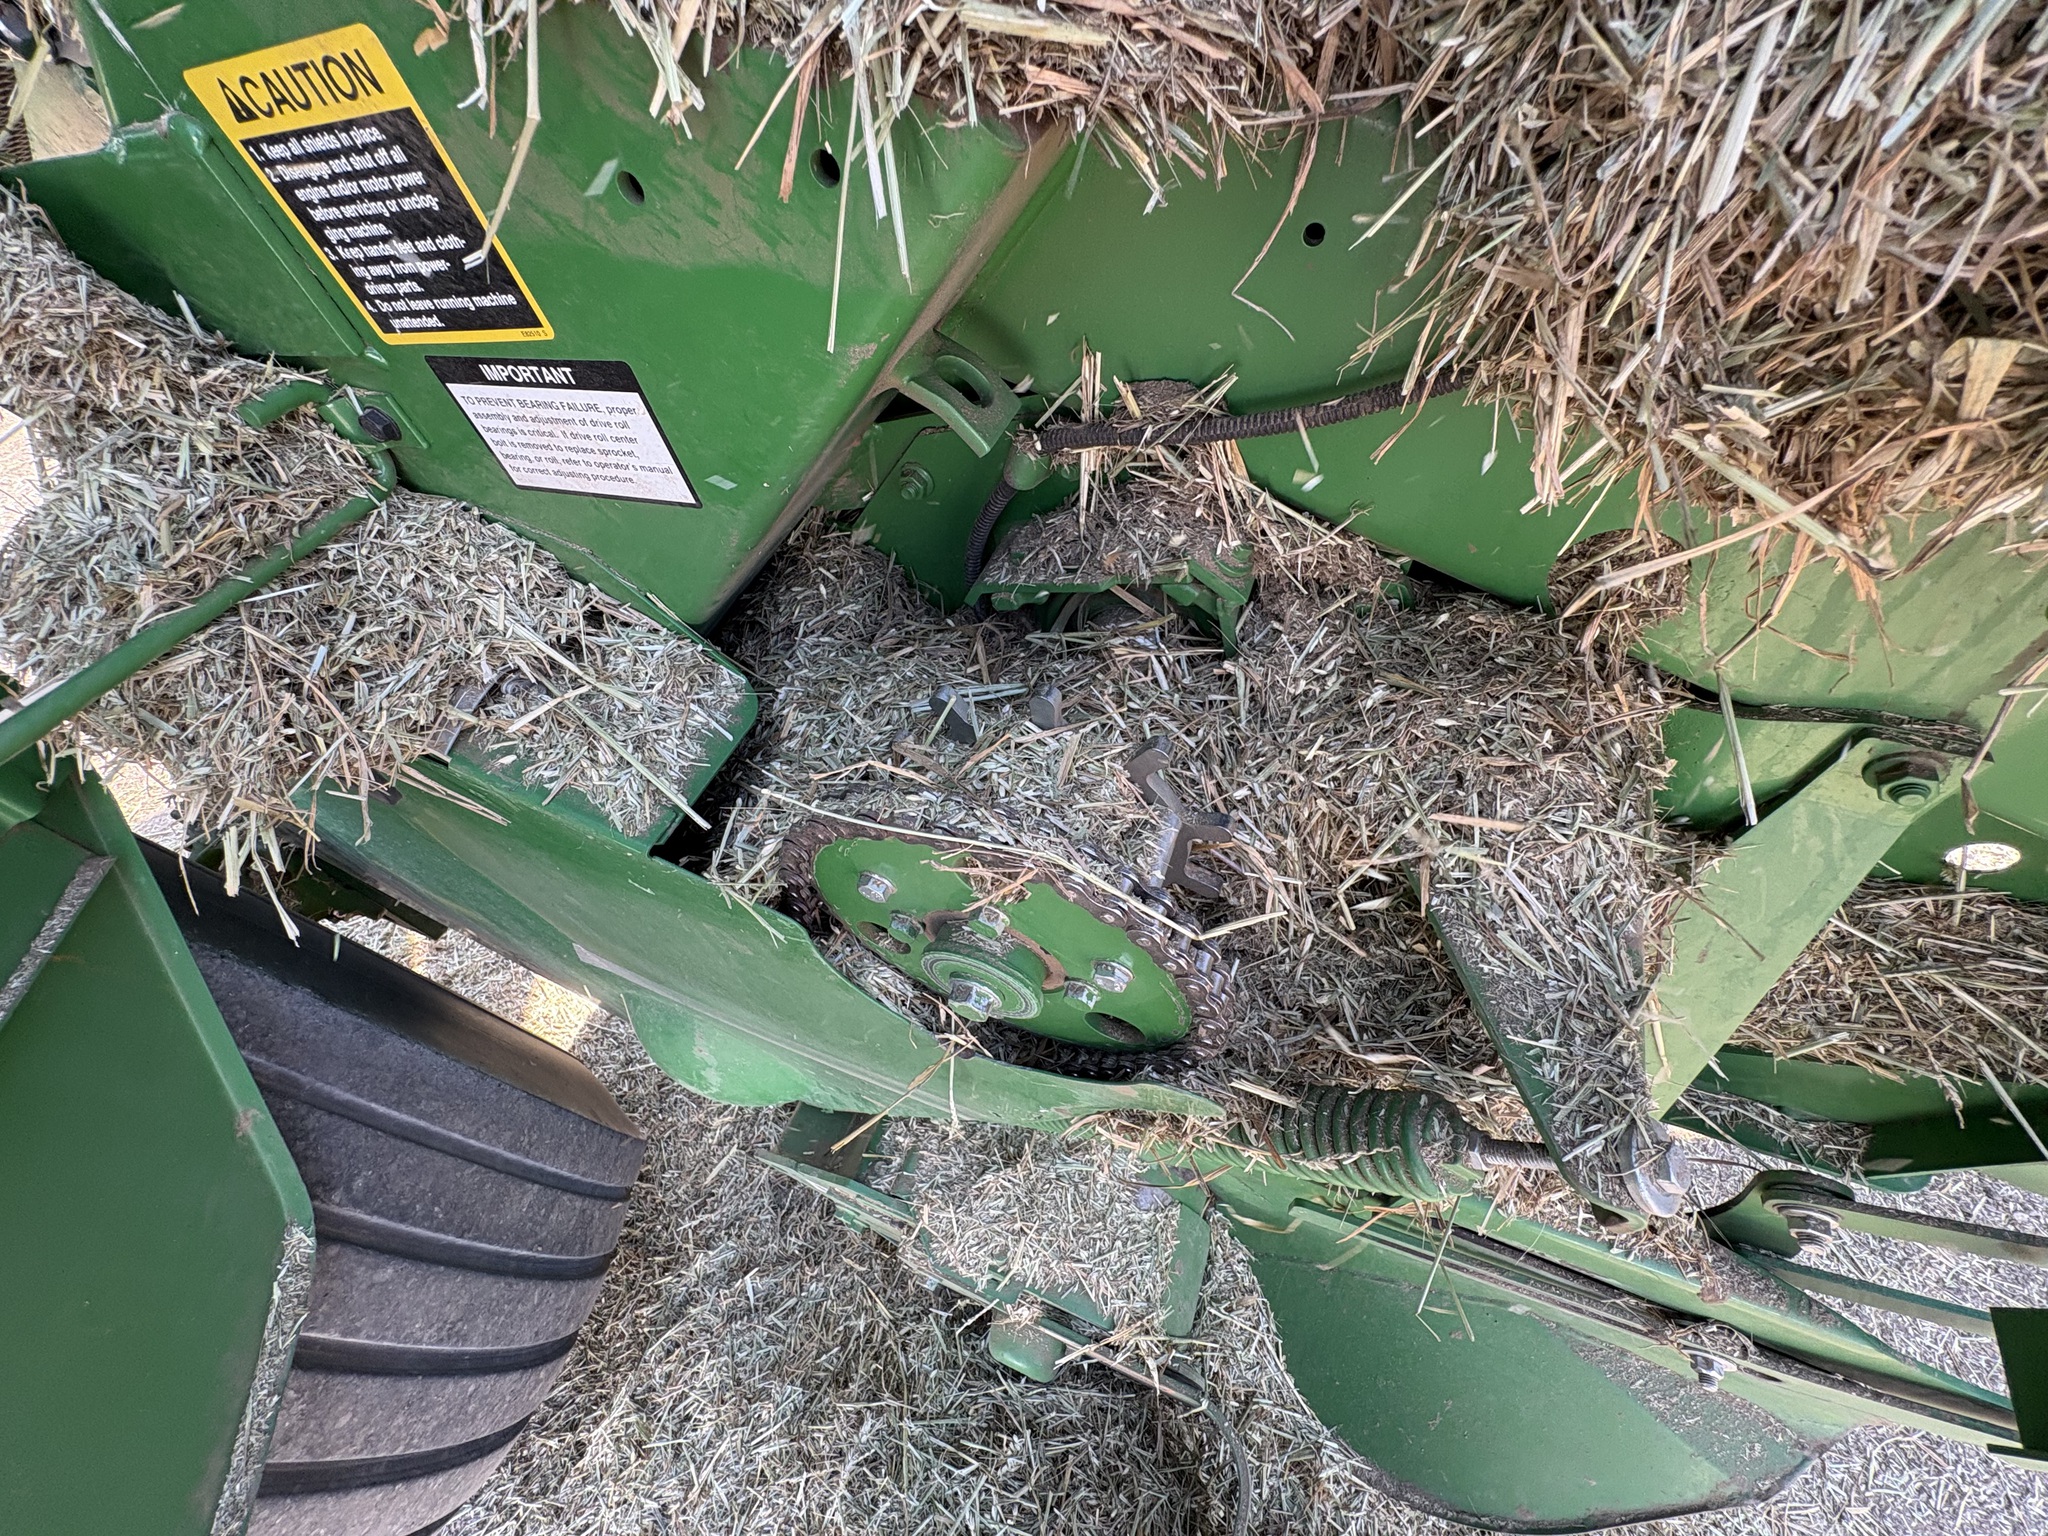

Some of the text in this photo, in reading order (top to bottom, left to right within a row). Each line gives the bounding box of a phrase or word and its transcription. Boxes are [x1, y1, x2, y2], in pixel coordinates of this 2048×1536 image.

[239, 48, 386, 119] CAUTION
[249, 125, 386, 162] 1. Keep all shields in place.
[264, 144, 408, 183] 2. Disengage and shut off all
[294, 171, 426, 204] engine and/or motor power
[306, 192, 440, 221] before servicing or unclog-
[324, 221, 393, 244] ging machine.
[324, 233, 467, 261] 3. Keep hands, feet and cloth-
[348, 259, 452, 280] ing away from power-
[364, 279, 425, 297] driven parts.
[365, 291, 518, 313] 4. Do not leave running machine
[389, 313, 446, 329] unattended.
[478, 363, 577, 386] IMPORTANT
[461, 395, 637, 417] TO PREVENT BEARING FAILURE, proper
[472, 411, 631, 430] assembly and adjustment of drive roll
[480, 424, 639, 445] bearings is critical. If drive roll center
[489, 437, 640, 460] bolt is removed to replace sprocket,
[508, 463, 522, 473] for
[522, 466, 552, 476] correct
[551, 469, 591, 481] adjusting
[544, 456, 563, 466] roll,
[562, 457, 581, 466] refer
[581, 459, 593, 468] to
[639, 465, 674, 475] manual
